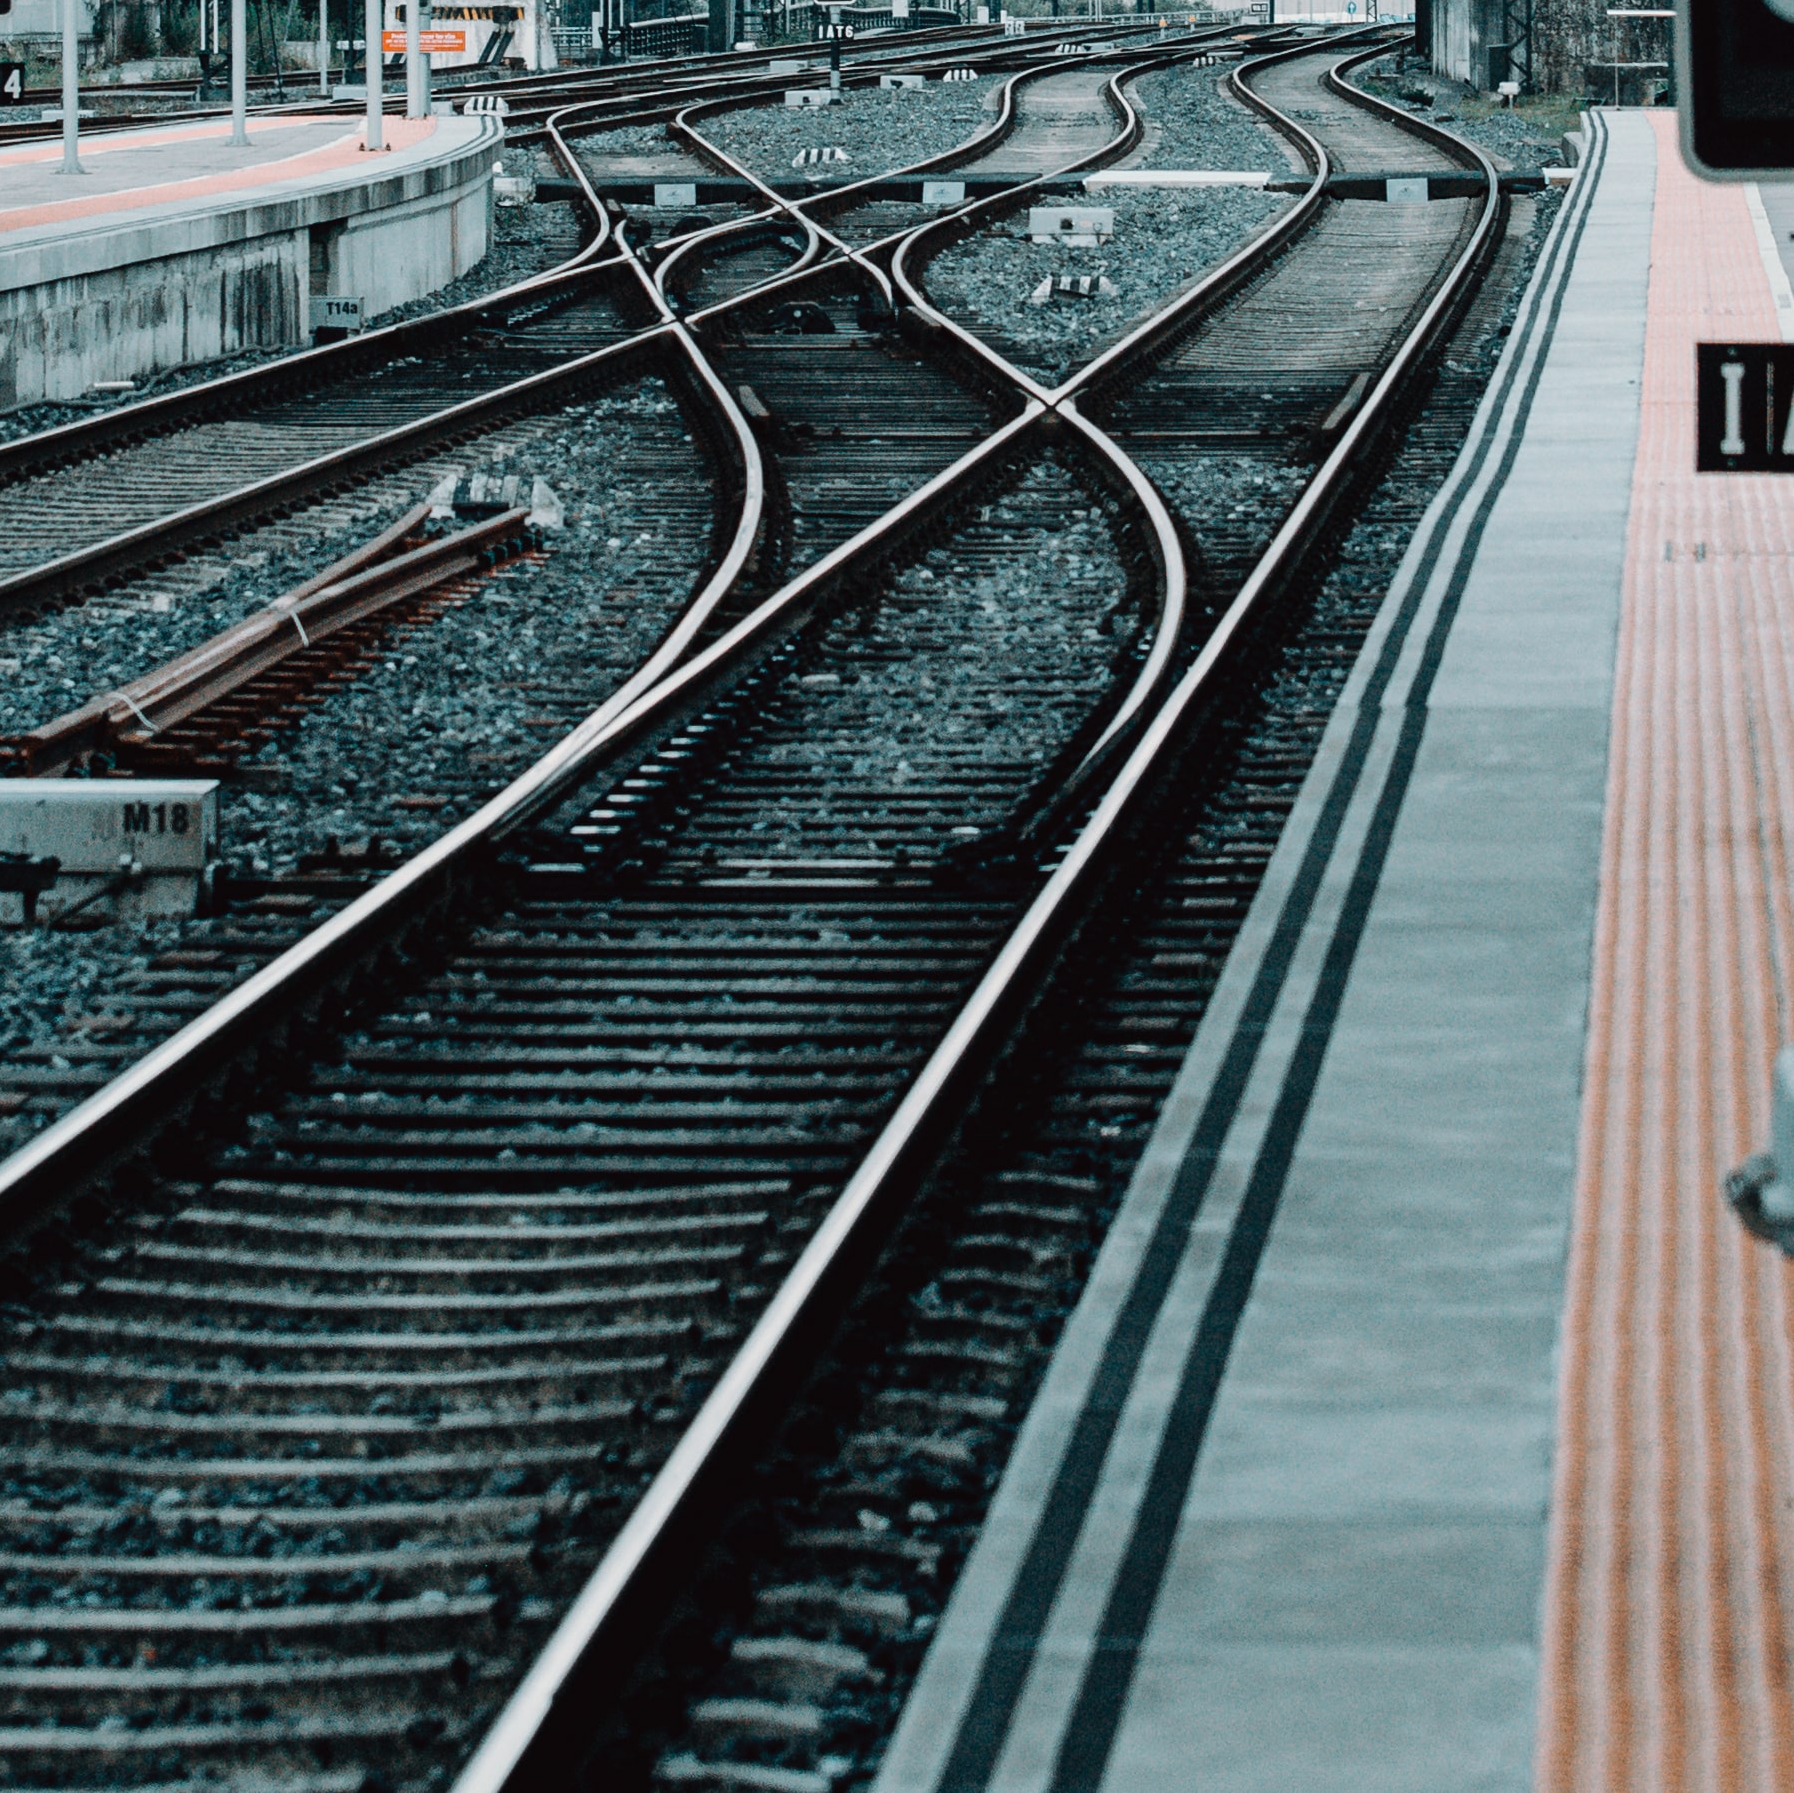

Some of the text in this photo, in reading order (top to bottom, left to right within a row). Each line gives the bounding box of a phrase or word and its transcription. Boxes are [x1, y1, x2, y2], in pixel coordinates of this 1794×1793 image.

[819, 24, 854, 39] IAT6
[326, 302, 358, 315] T14a
[123, 802, 189, 834] M18
